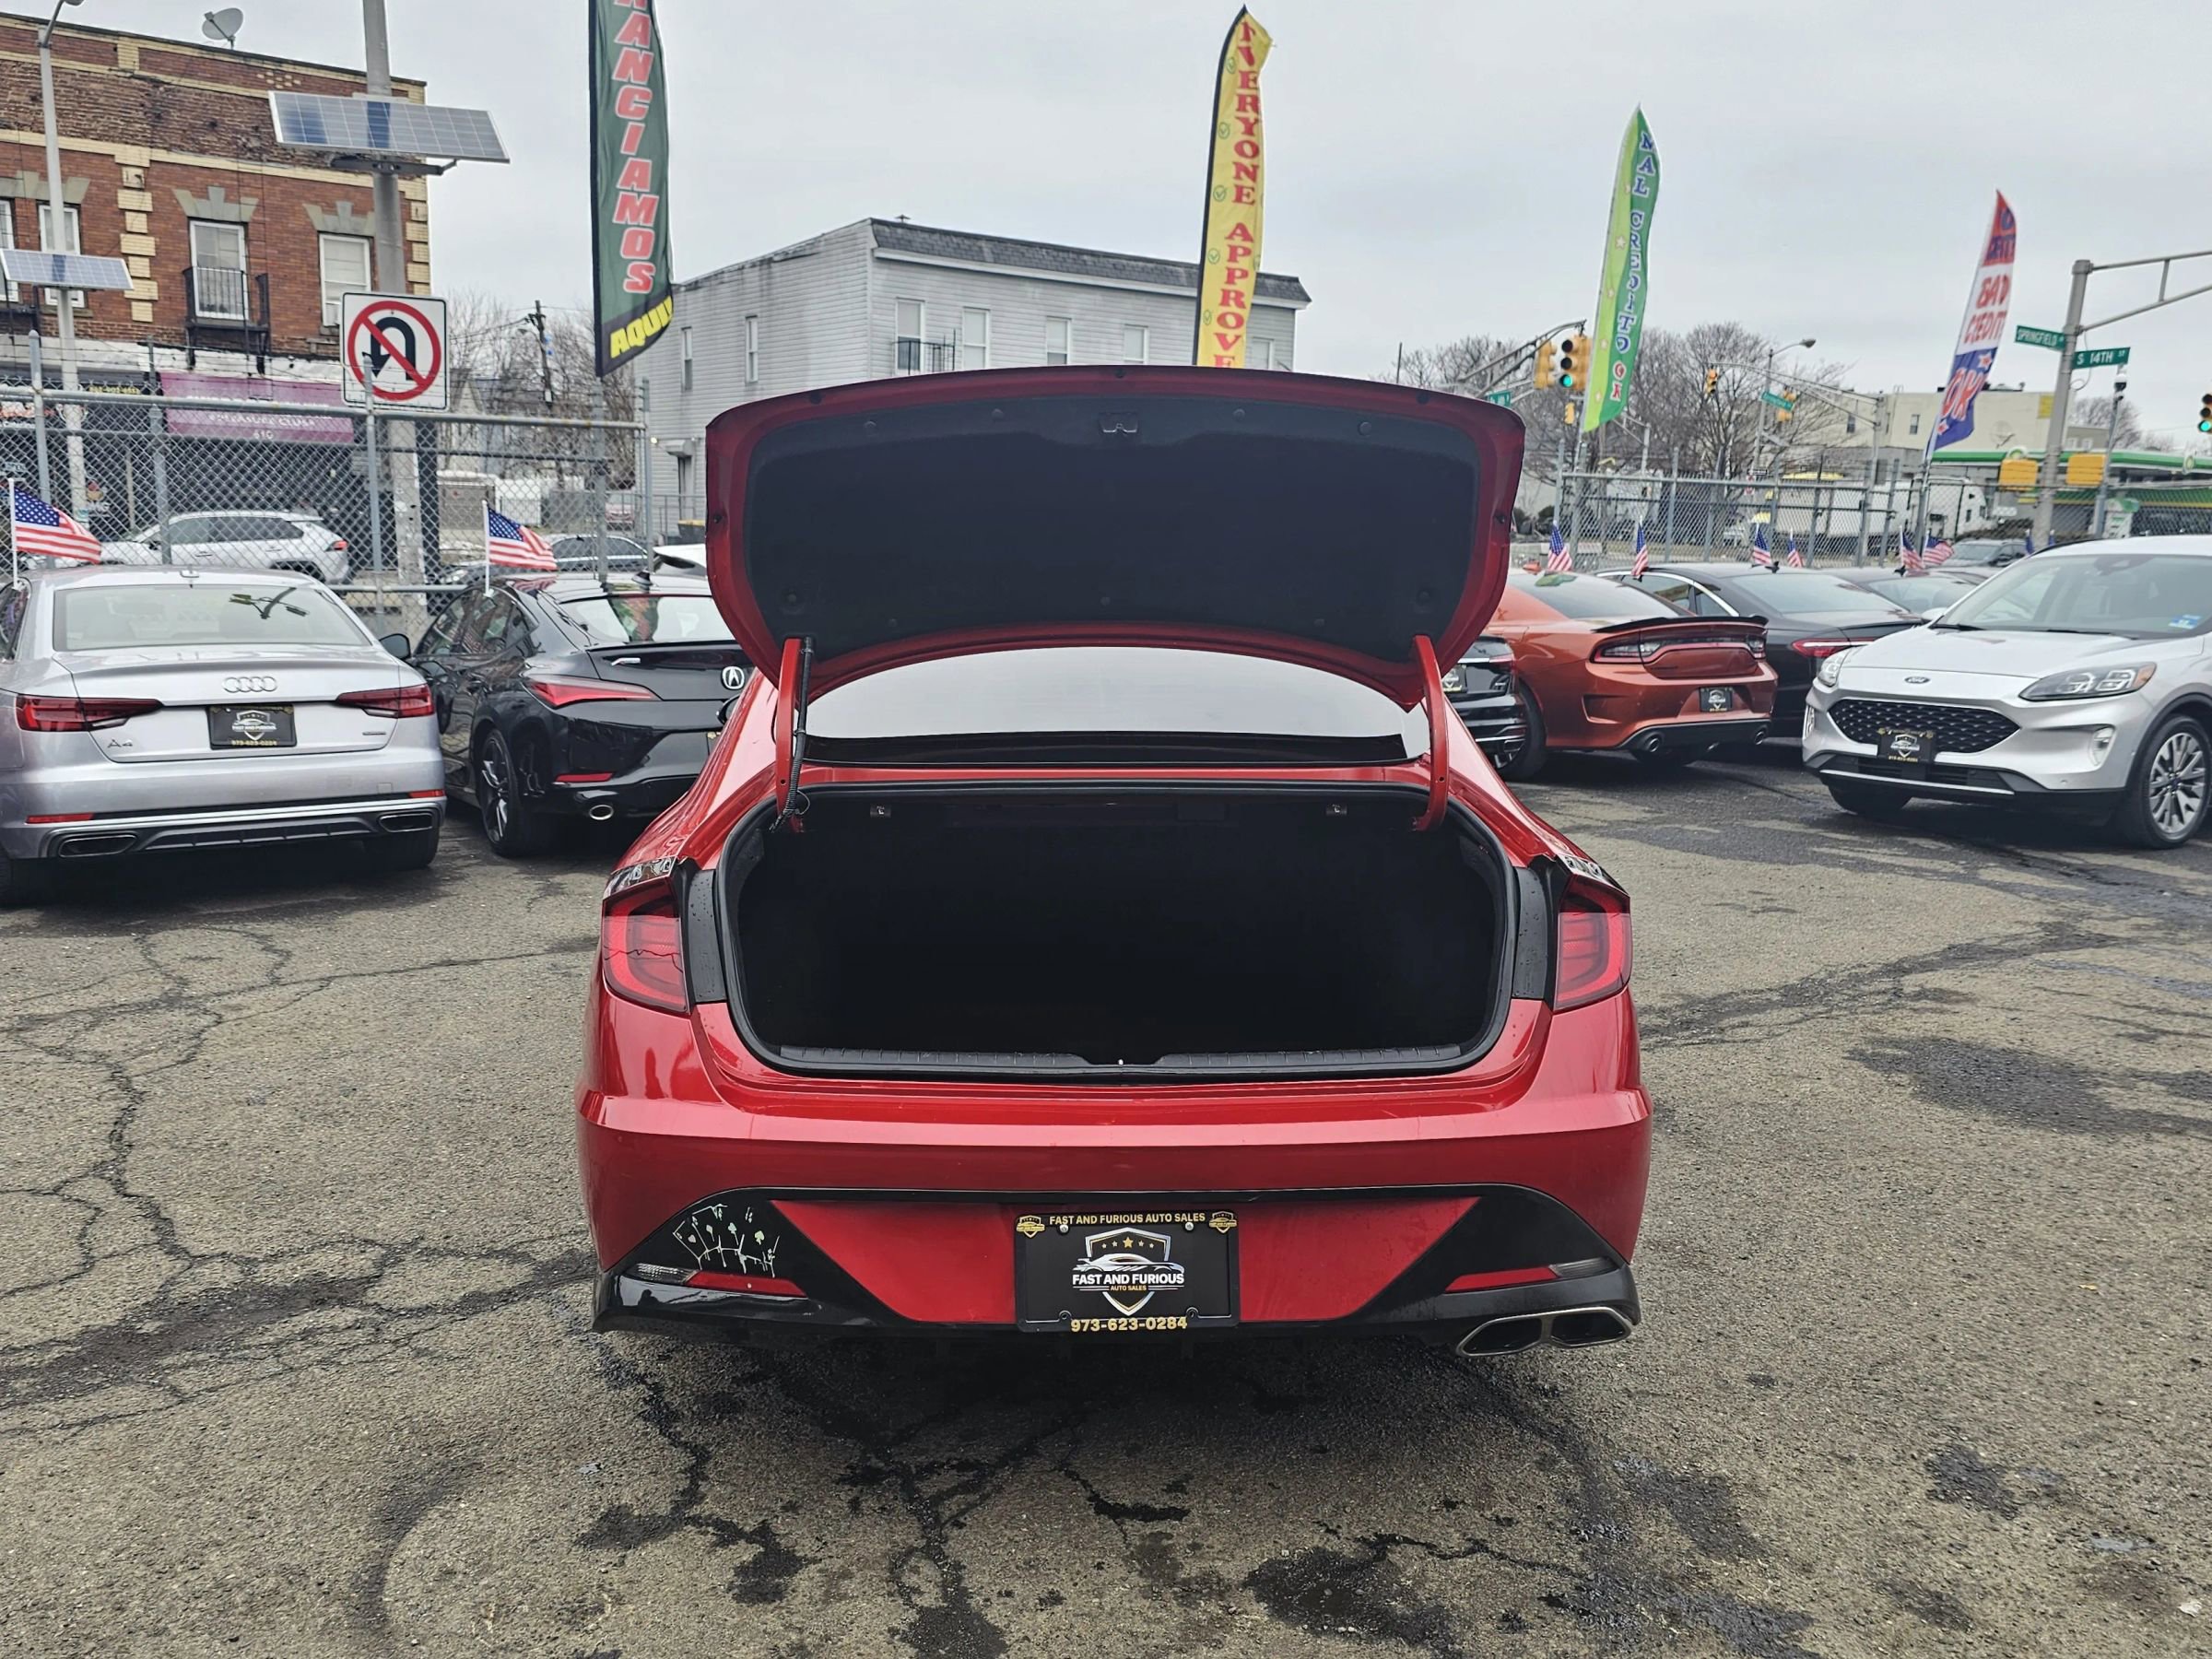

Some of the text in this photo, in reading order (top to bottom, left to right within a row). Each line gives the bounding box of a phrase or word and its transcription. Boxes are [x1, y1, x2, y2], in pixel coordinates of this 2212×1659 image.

[612, 0, 659, 294] ANCIAMOS
[1976, 274, 2010, 309] BAD
[2077, 354, 2085, 366] S
[2089, 351, 2113, 364] 14TH
[1940, 368, 1987, 421] OK
[107, 738, 134, 748] A4
[1050, 1212, 1206, 1225] FAST AND FURIOUS AUTO SALES
[1072, 1273, 1184, 1285] FAST AND FURIOUS
[1070, 1316, 1188, 1332] 973-623-0284
